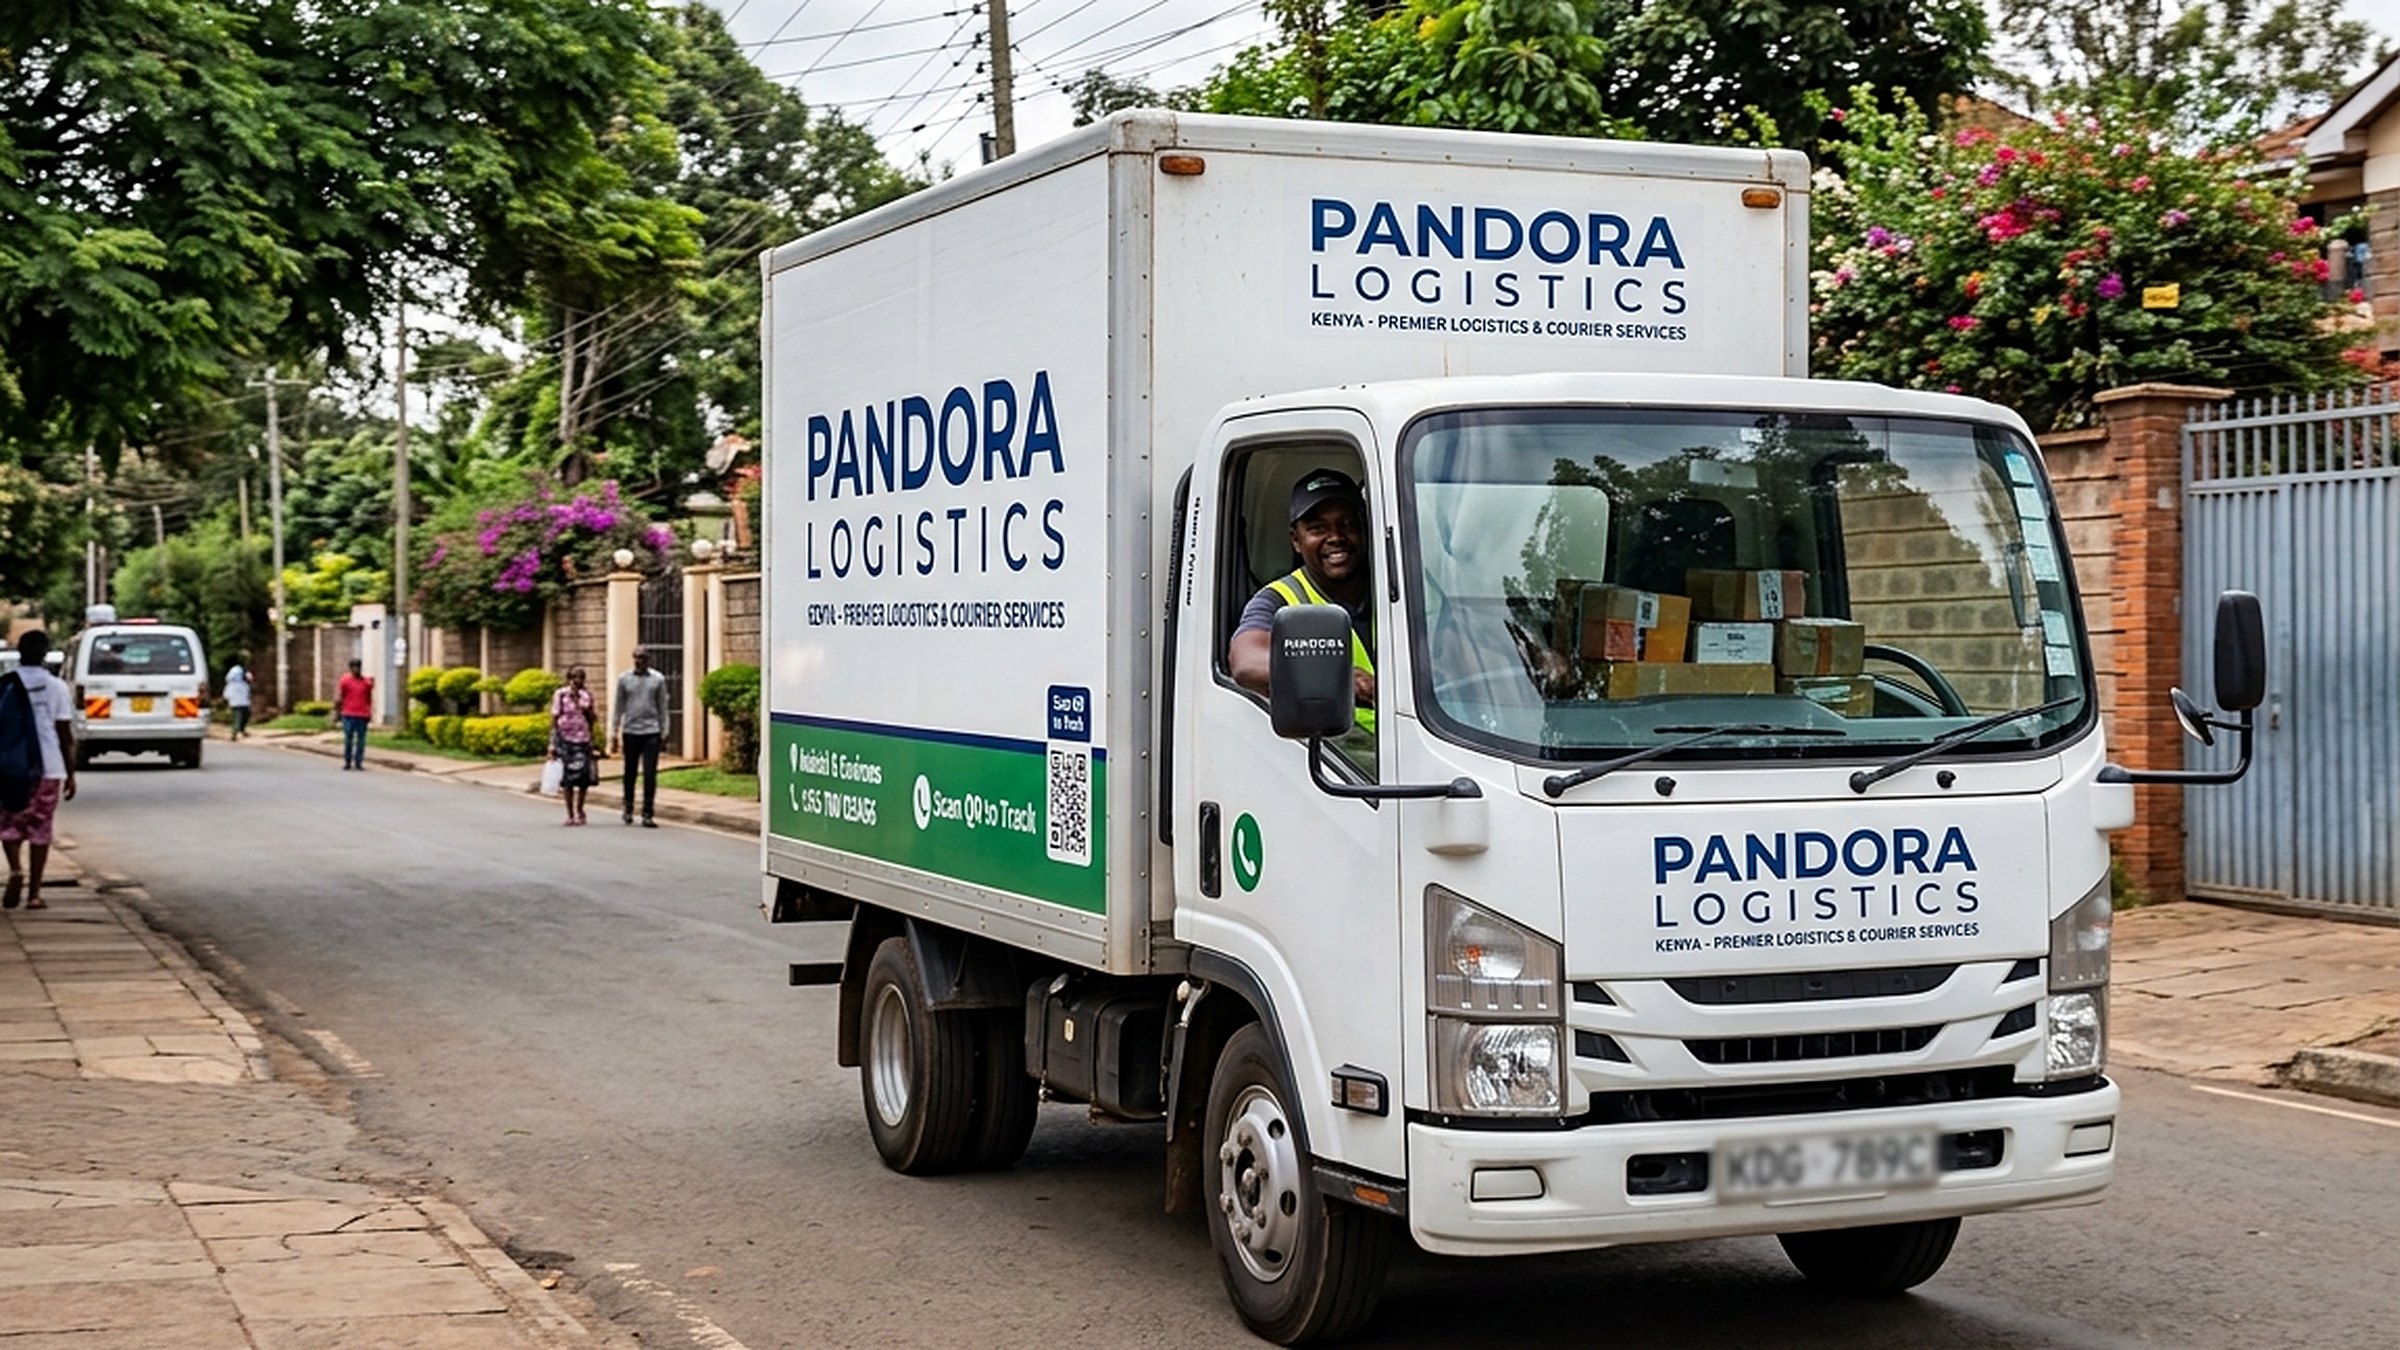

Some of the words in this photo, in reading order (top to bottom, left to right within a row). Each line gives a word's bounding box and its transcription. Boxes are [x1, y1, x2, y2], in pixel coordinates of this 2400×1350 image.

[1311, 199, 1686, 269] PANDORA
[1312, 264, 1687, 314] LOGISTICS
[1311, 312, 1364, 328] KENYA
[1378, 314, 1447, 331] PREMIER
[1451, 317, 1529, 334] LOGISTICS
[1532, 320, 1543, 334] &
[1546, 321, 1613, 338] COURIER
[1616, 324, 1687, 340] SERVICES
[807, 369, 1065, 501] PANDORA
[807, 498, 1065, 580] LOGISTICS
[950, 601, 1002, 628] COURIER
[1004, 601, 1066, 628] SERVICES
[933, 790, 963, 820] Scan
[1653, 826, 1978, 885] PANDORA
[1656, 881, 1979, 927] LOGISTICS
[1655, 938, 1702, 952] KENYA
[1776, 930, 1845, 947] LOGISTICS
[1859, 926, 1916, 942] COURIER
[1919, 922, 1980, 938] SERVICES
